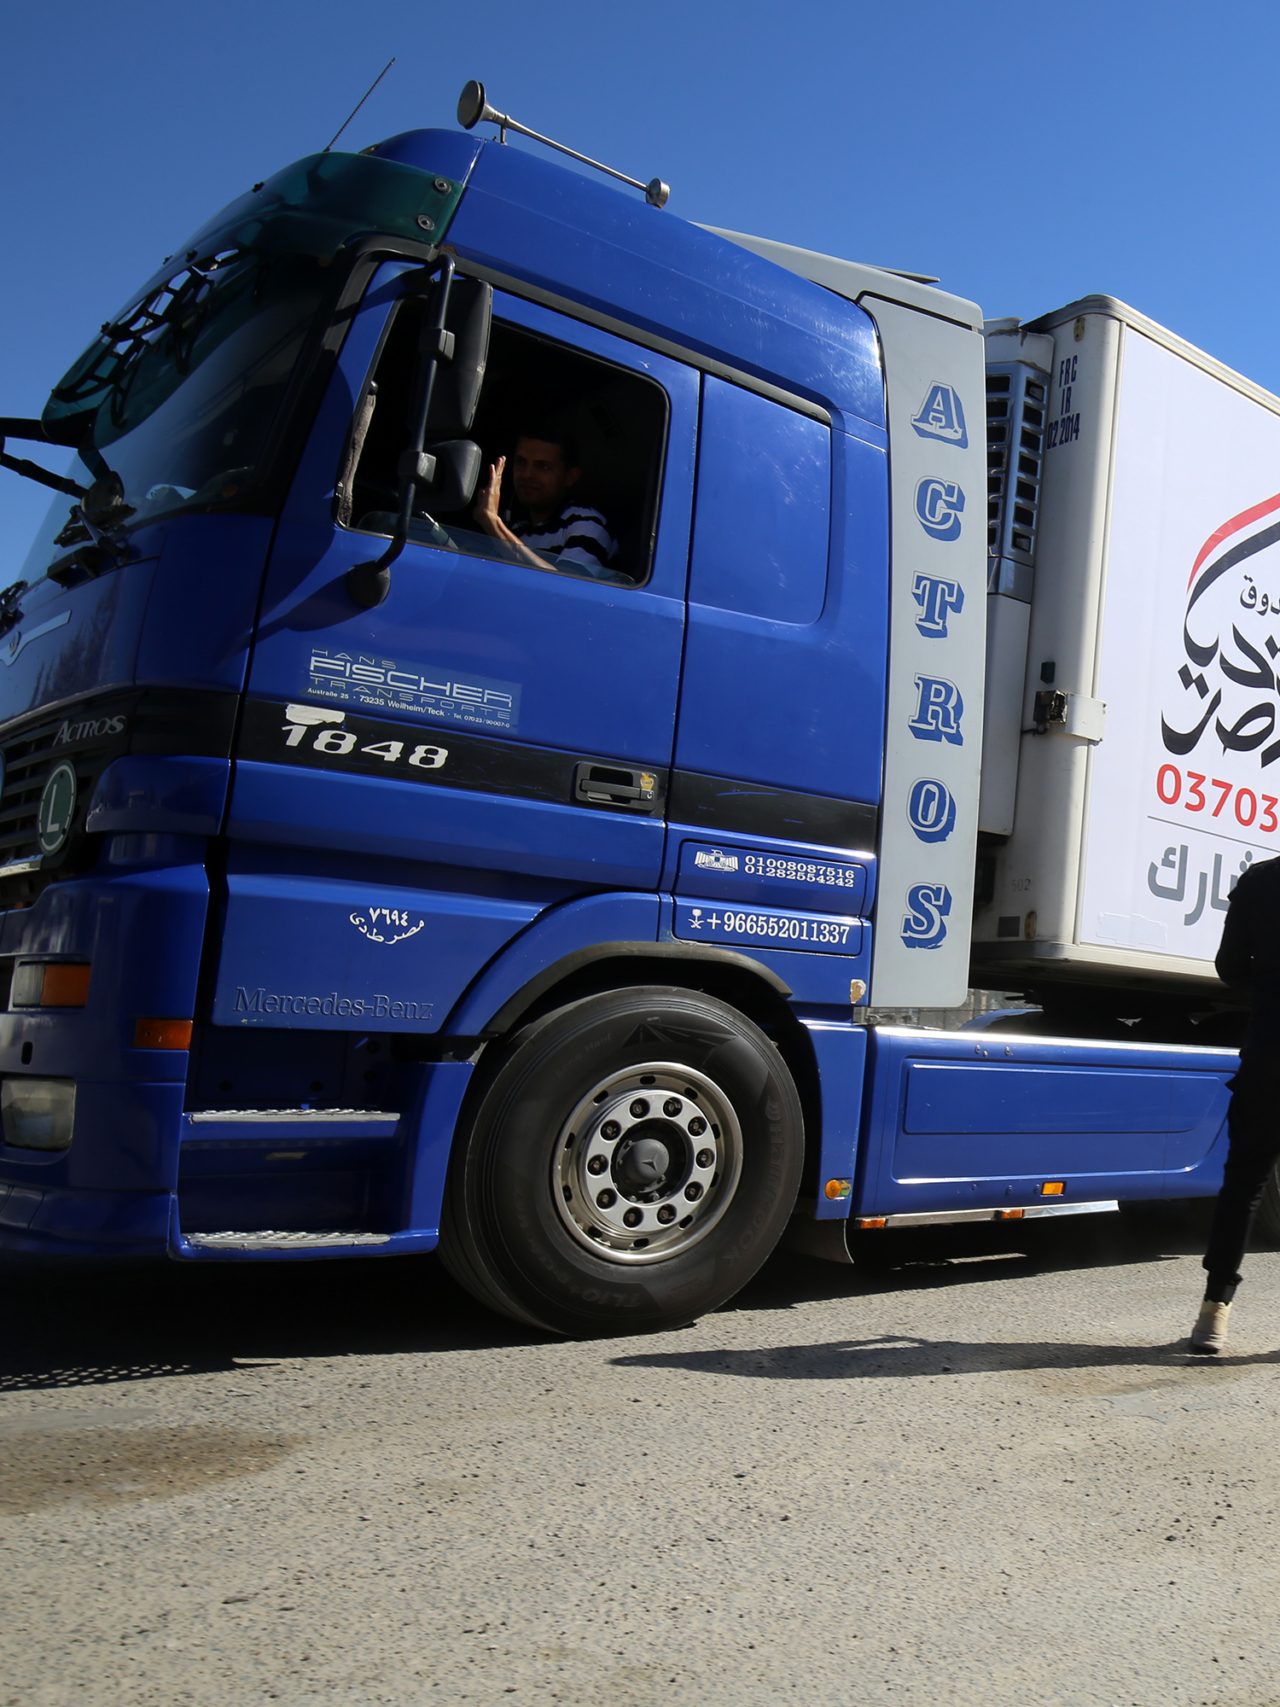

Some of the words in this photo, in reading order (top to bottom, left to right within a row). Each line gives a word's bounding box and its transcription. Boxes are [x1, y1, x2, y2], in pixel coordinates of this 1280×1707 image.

[312, 648, 396, 670] HANS
[901, 380, 968, 950] ACTROS
[310, 656, 512, 708] FISCHER
[310, 677, 510, 720] TRANSPORTE
[360, 694, 384, 706] 73235
[281, 724, 449, 769] 1848
[744, 864, 854, 888] 01282554242
[745, 855, 855, 879] 01008087516
[385, 919, 425, 945] مصر
[706, 911, 850, 945] +966552011337
[232, 986, 435, 1021] Mercedes-Benz
